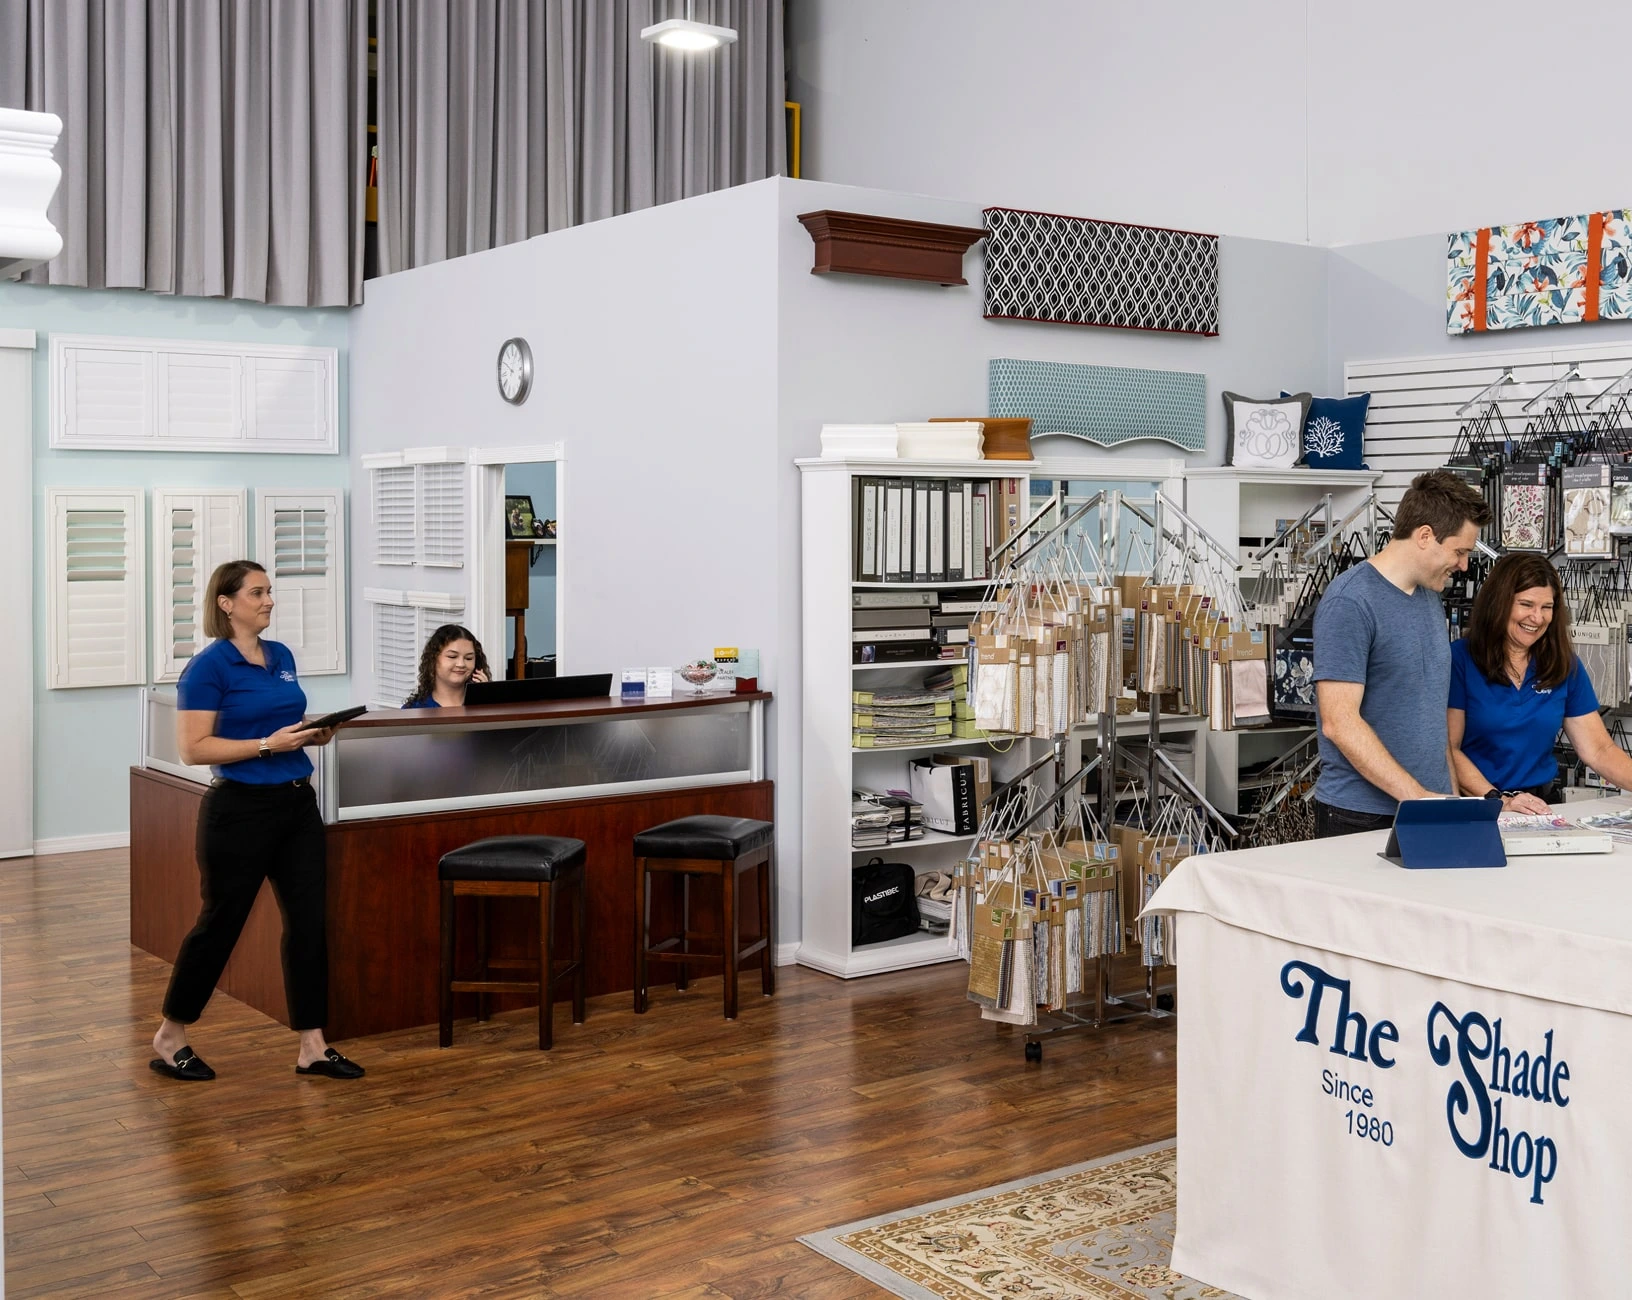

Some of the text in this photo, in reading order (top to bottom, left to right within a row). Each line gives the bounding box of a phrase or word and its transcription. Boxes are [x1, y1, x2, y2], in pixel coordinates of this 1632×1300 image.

[959, 769, 971, 831] FABRICUT
[863, 885, 900, 904] PLASTIBEC
[1280, 960, 1571, 1140] The Shade
[1321, 1069, 1374, 1108] Since
[1345, 1109, 1394, 1147] 1980
